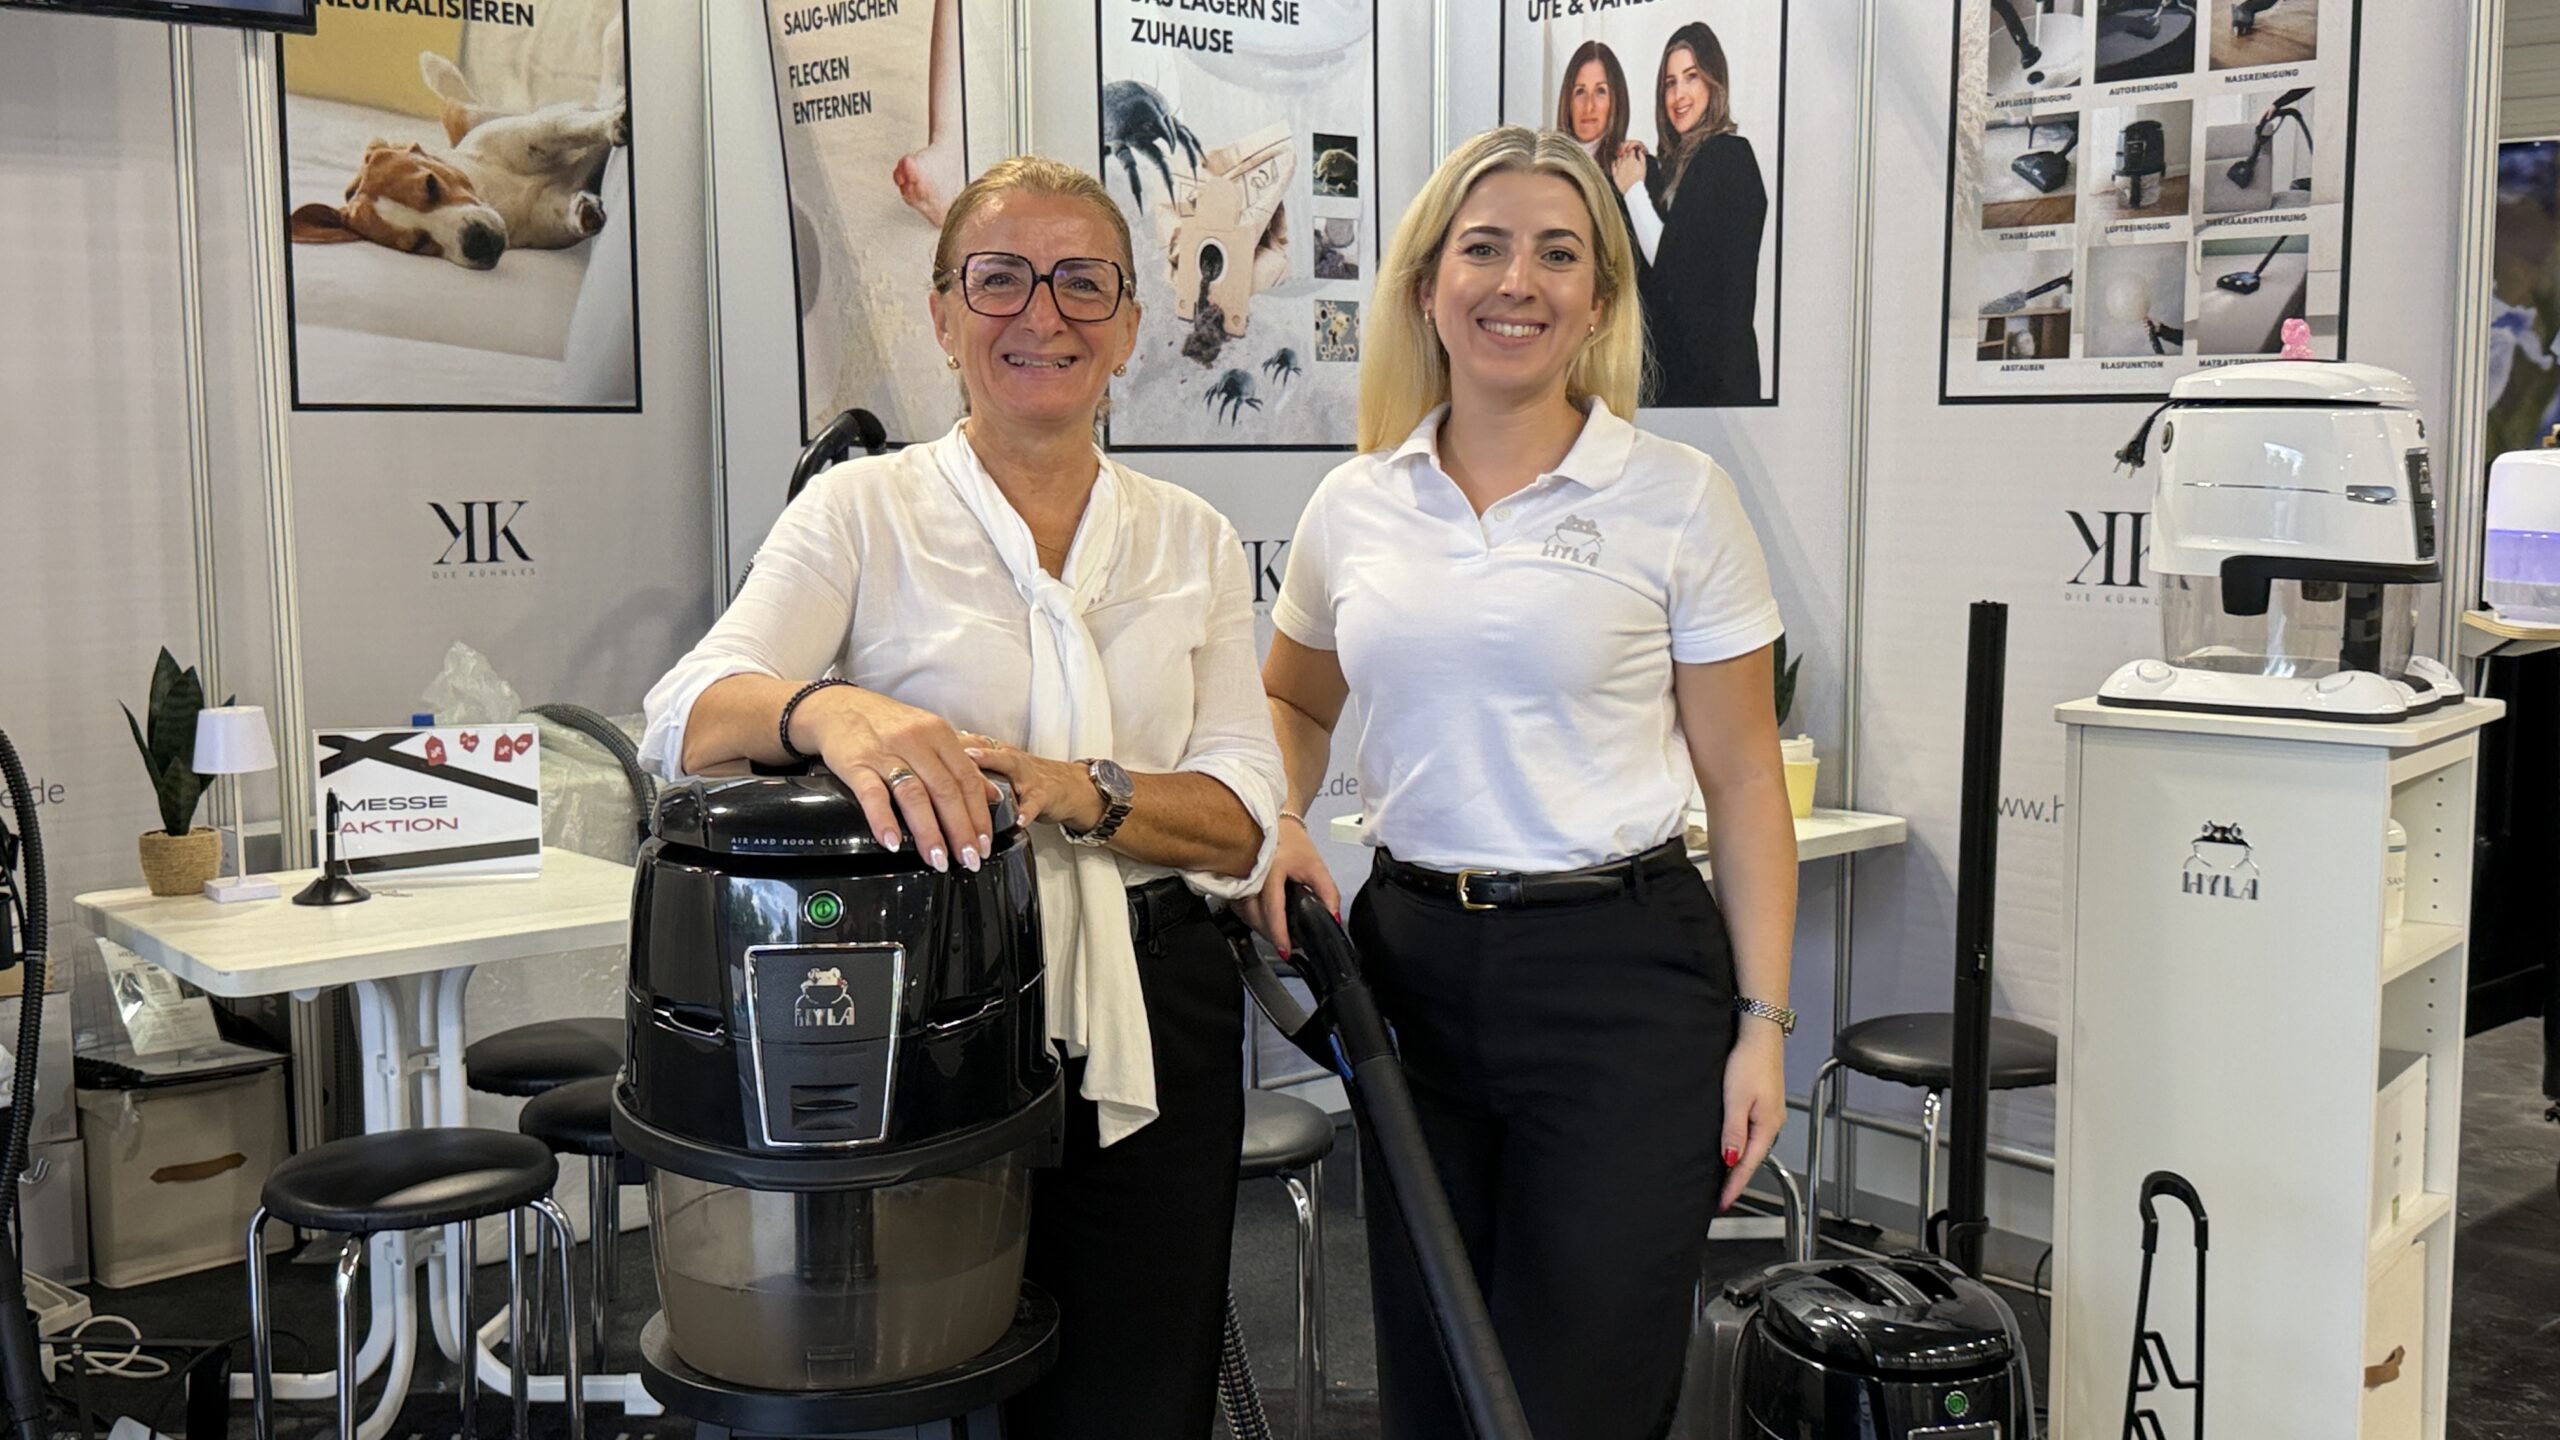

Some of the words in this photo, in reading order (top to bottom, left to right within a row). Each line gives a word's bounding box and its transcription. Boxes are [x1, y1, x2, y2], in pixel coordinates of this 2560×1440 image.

[784, 0, 899, 36] SAUG-WISCHEN
[1271, 0, 1300, 25] SIE
[1528, 0, 1562, 22] UTE
[1131, 18, 1234, 54] ZUHAUSE
[788, 56, 850, 89] FLECKEN
[2224, 69, 2299, 83] NASSREINIGUNG
[2108, 81, 2178, 96] AUTOREINIGUNG
[793, 91, 873, 125] ENTFERNEN
[1999, 230, 2056, 240] STAUBSAUGEN
[2104, 222, 2171, 234] LUFTREINIGUNG
[2100, 361, 2164, 370] BLASFUNKTION
[1541, 543, 1599, 567] HYLA
[2064, 592, 2092, 602] DIE
[339, 795, 448, 812] MESSE
[339, 817, 459, 834] AKTION
[754, 837, 777, 845] AND
[2182, 871, 2259, 900] HYLA
[795, 1008, 856, 1026] HYLA
